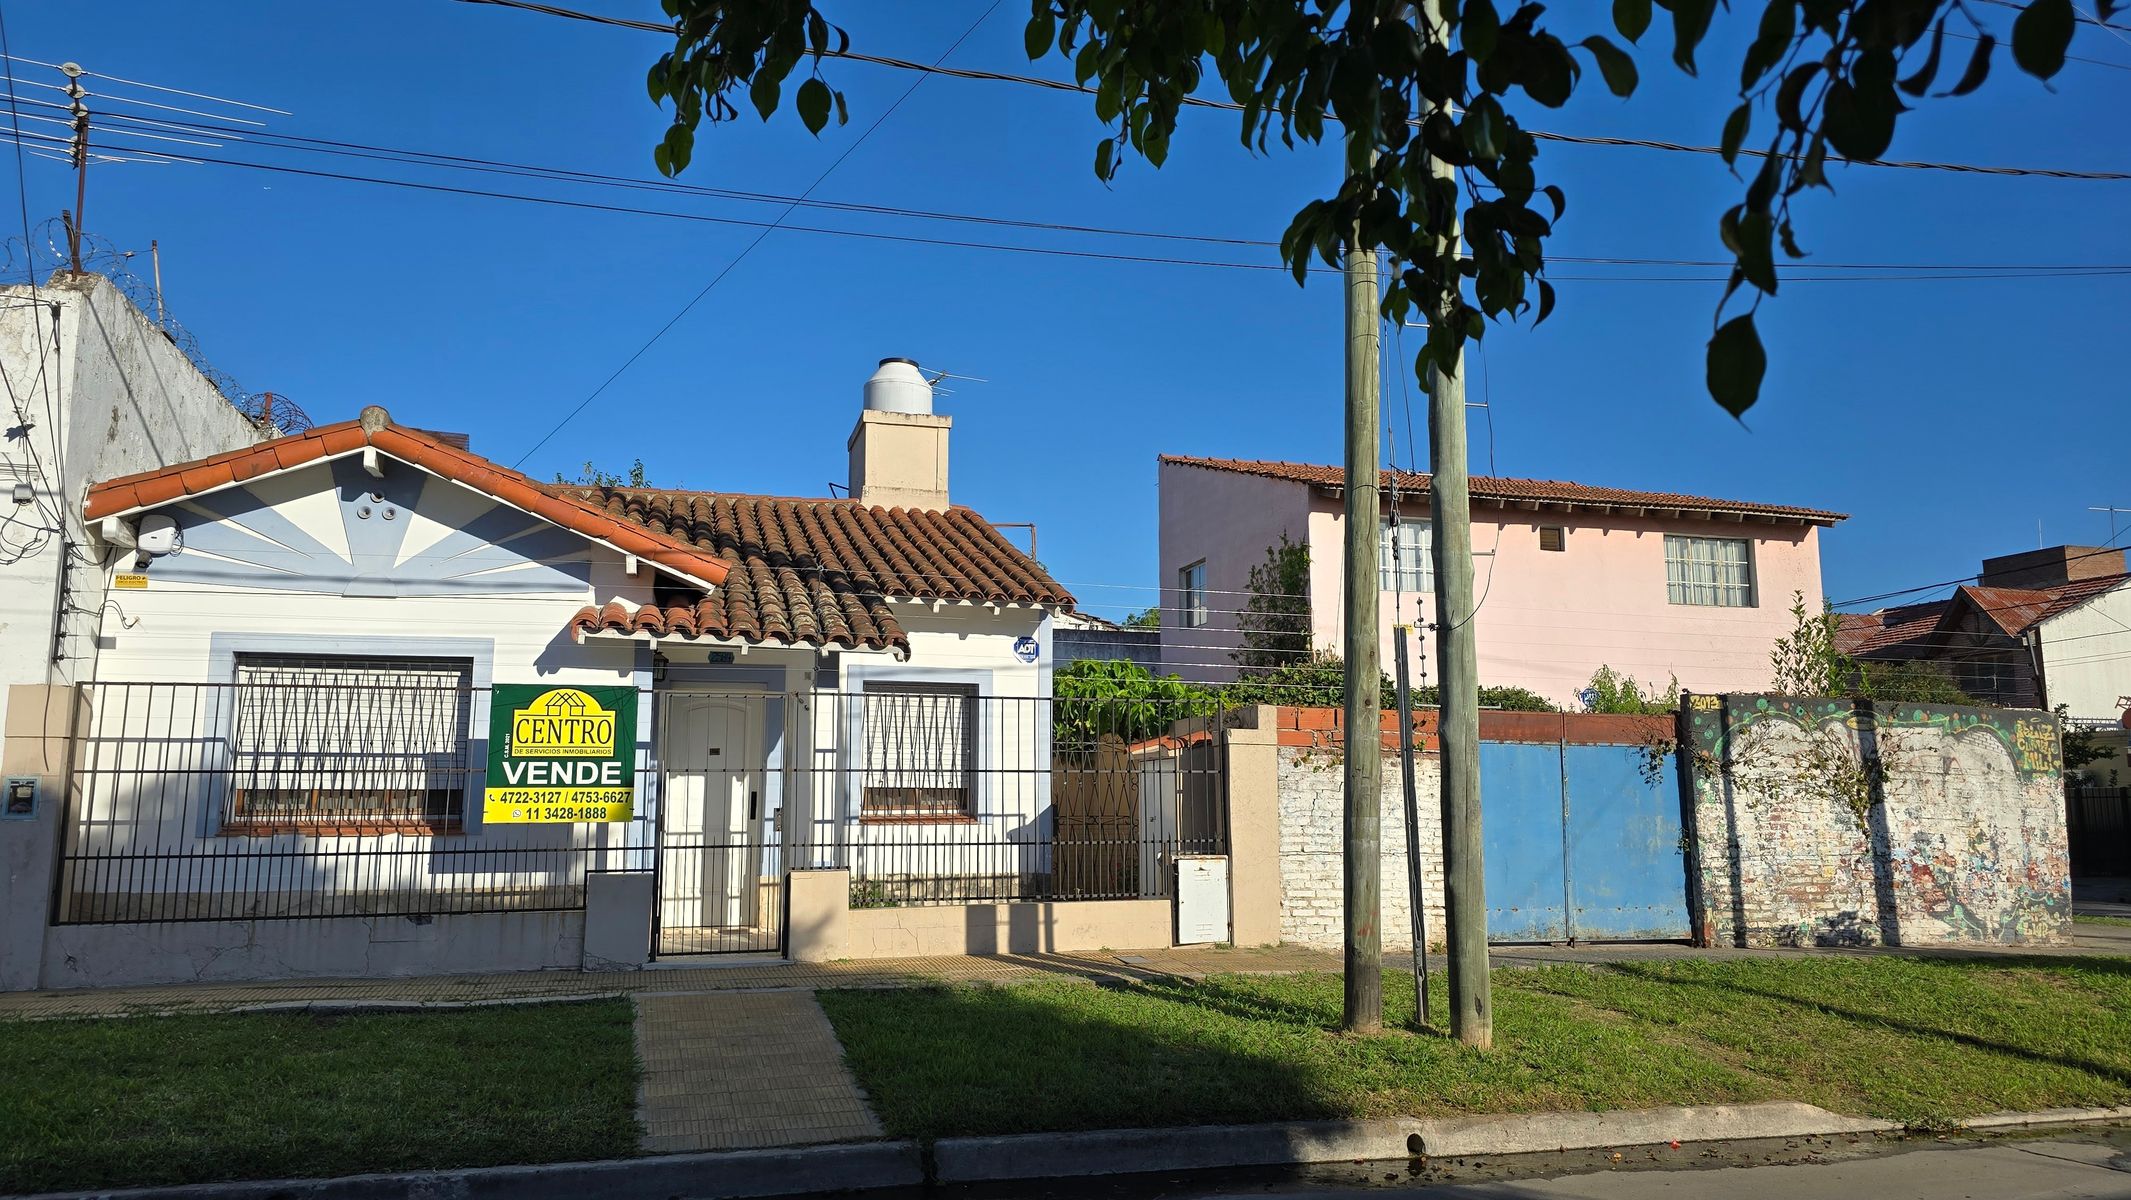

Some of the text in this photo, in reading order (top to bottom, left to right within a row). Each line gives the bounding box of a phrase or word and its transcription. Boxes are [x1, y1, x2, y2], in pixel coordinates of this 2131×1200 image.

[1018, 643, 1035, 653] ADT
[516, 718, 612, 744] CENTRO
[502, 761, 622, 785] VENDE
[500, 791, 561, 804] 4722-3127
[571, 791, 631, 803] 4753-6627
[526, 807, 607, 820] 11 3428-1888
